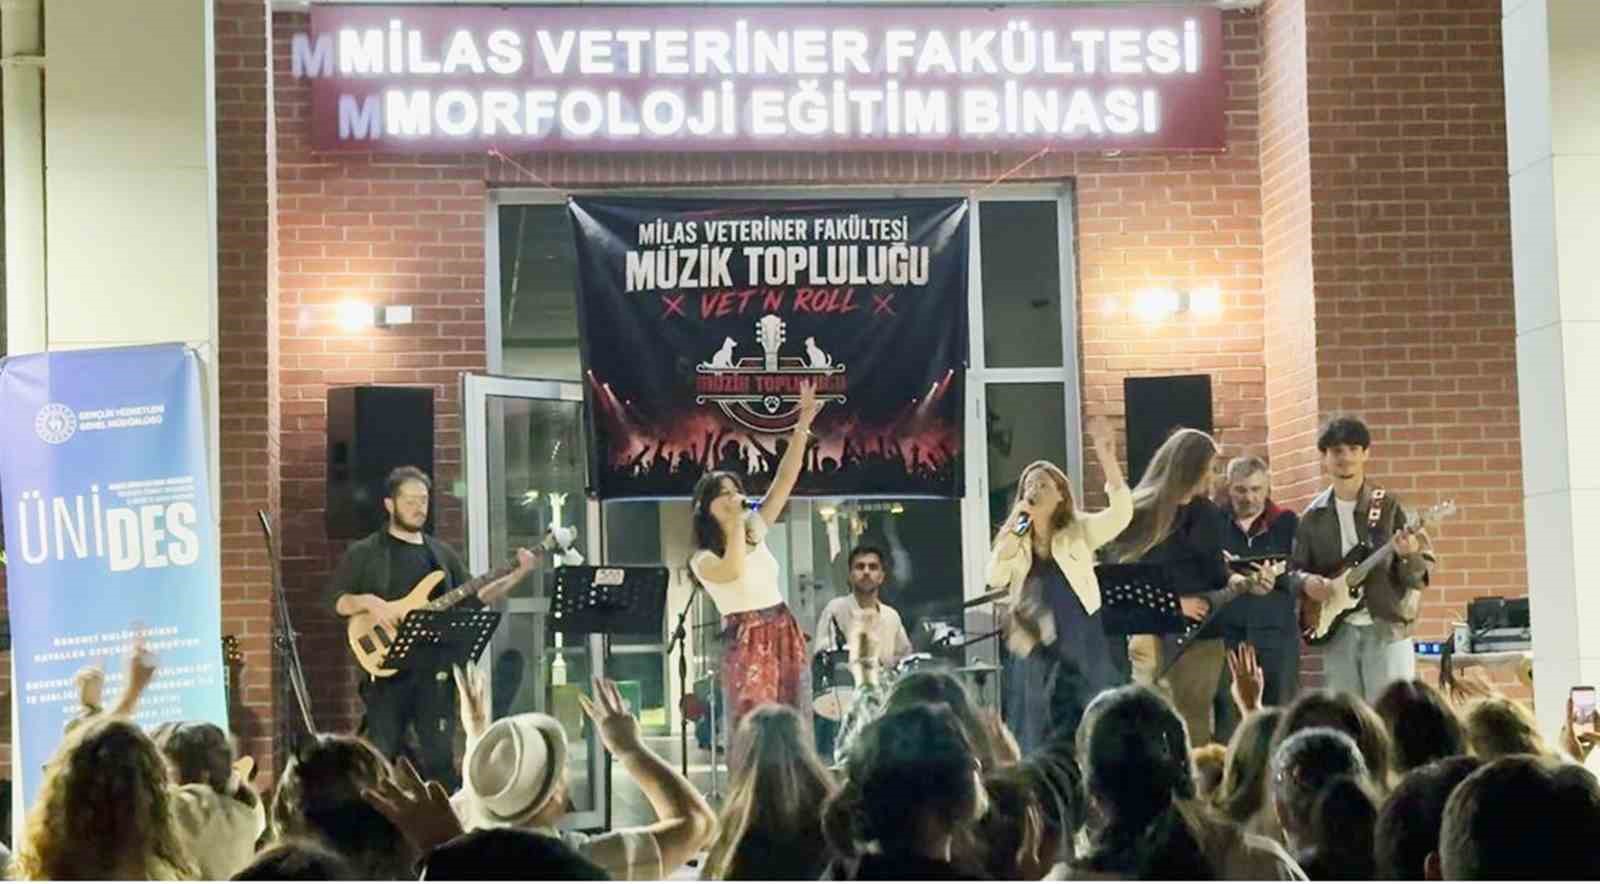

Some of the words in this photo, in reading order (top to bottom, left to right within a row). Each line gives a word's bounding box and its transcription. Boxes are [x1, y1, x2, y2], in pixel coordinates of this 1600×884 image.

[338, 20, 523, 75] MİLAS
[537, 20, 870, 75] VETERİNER
[885, 19, 1198, 74] FAKÜLTESİ
[385, 81, 736, 137] MORFOLOJİ
[750, 80, 948, 135] EĞİTİM
[963, 81, 1160, 134] BİNASI
[638, 218, 698, 246] MİLAS
[705, 215, 807, 243] VETERİNER
[813, 214, 909, 241] FAKÜLTESİ
[624, 243, 734, 293] MÜZİK
[743, 242, 930, 288] TOPLULUĞU
[792, 286, 858, 314] ROLL
